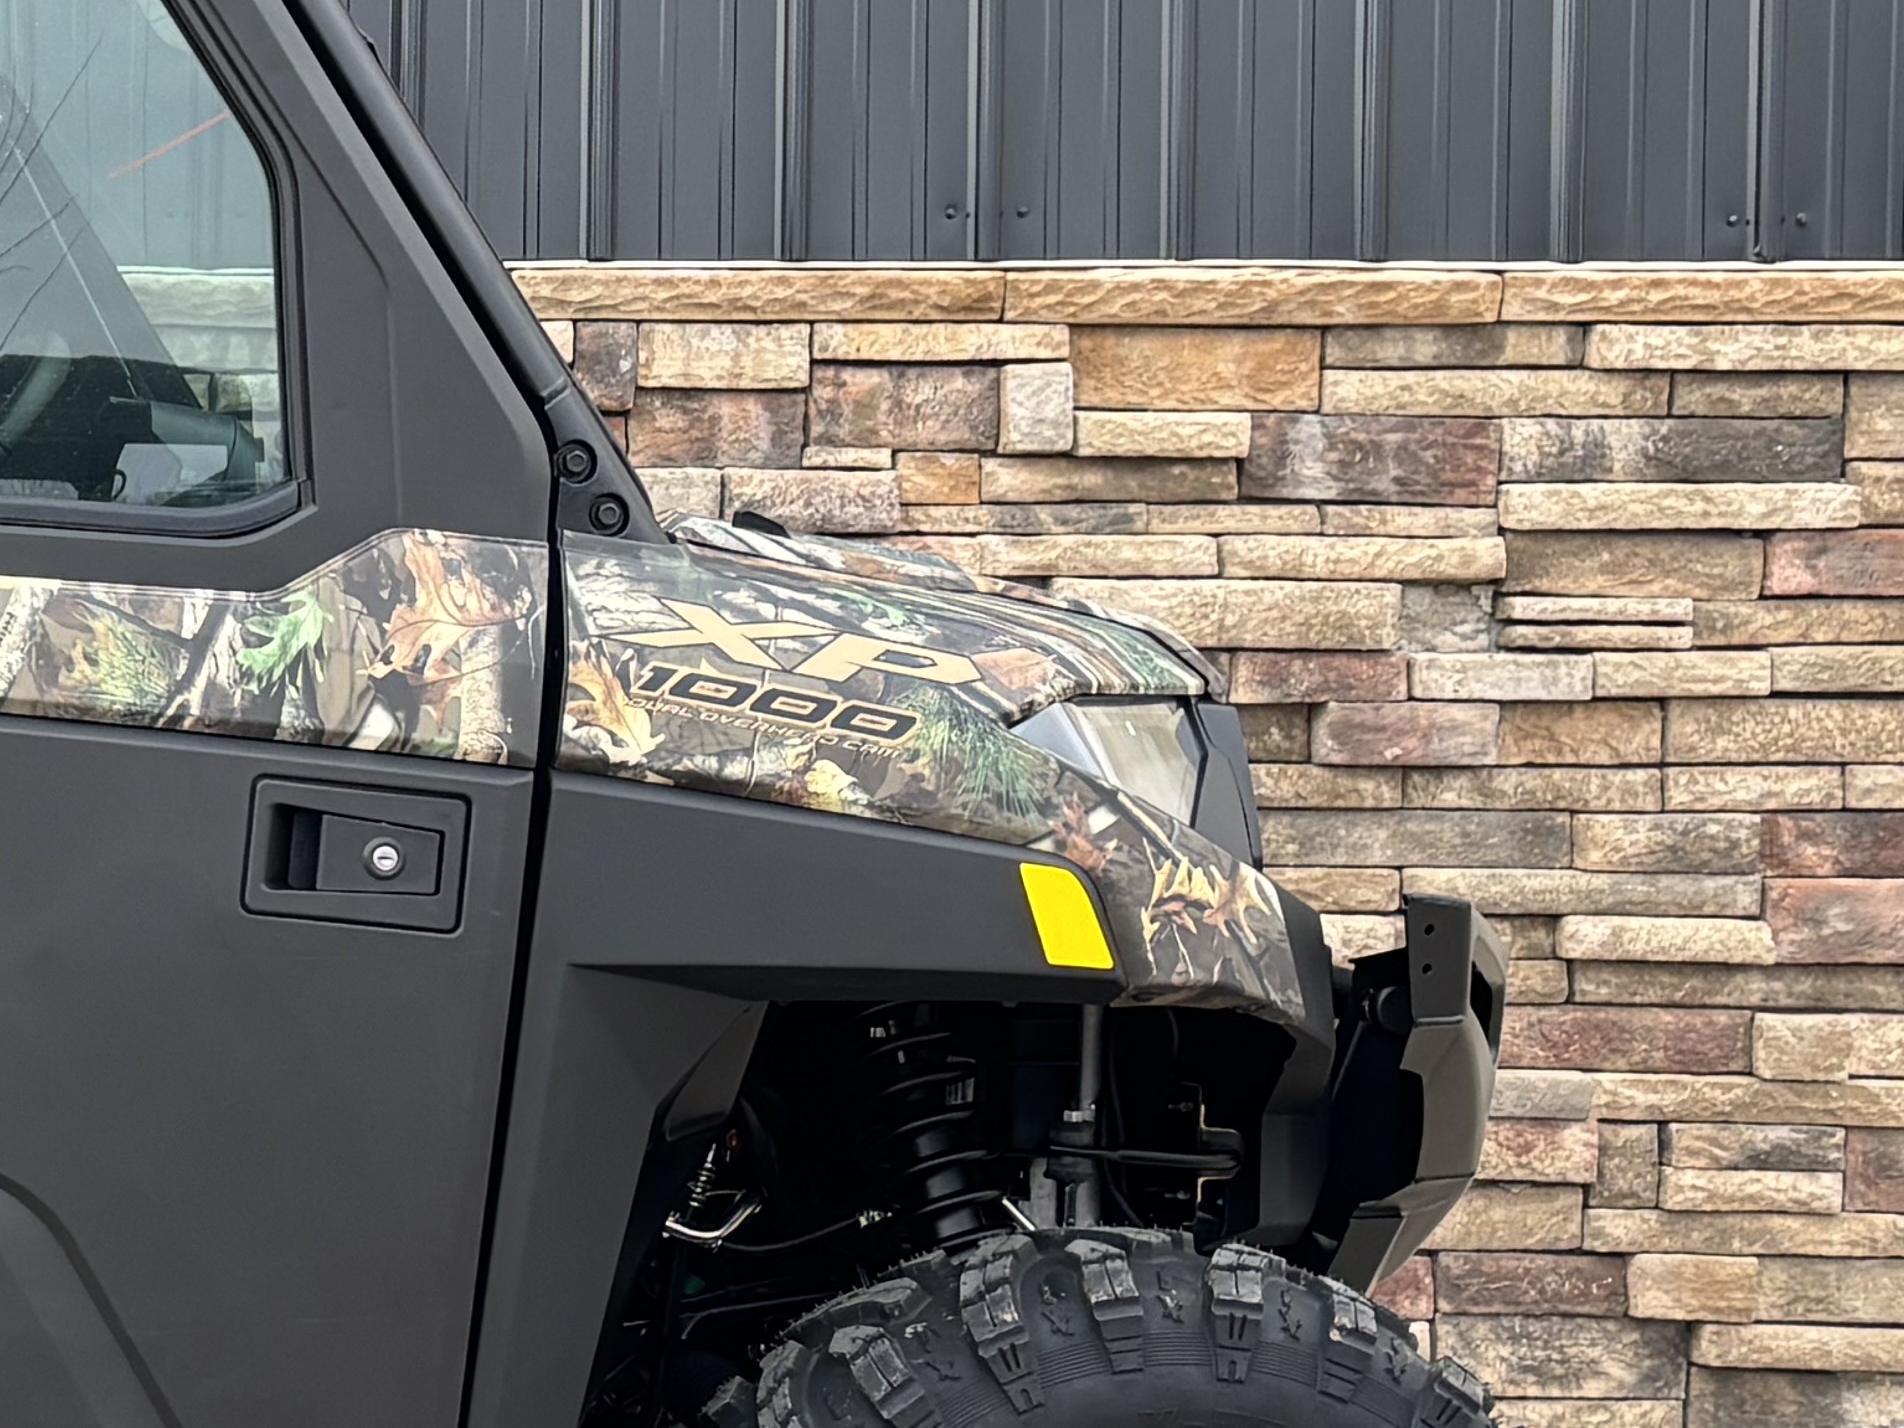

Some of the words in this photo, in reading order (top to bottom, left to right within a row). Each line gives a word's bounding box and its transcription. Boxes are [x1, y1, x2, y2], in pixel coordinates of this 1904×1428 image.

[598, 596, 985, 686] XP
[627, 698, 693, 719] DUAL
[700, 712, 839, 745] OVERHEAD
[842, 738, 904, 760] CAM
[629, 661, 922, 747] 1000
